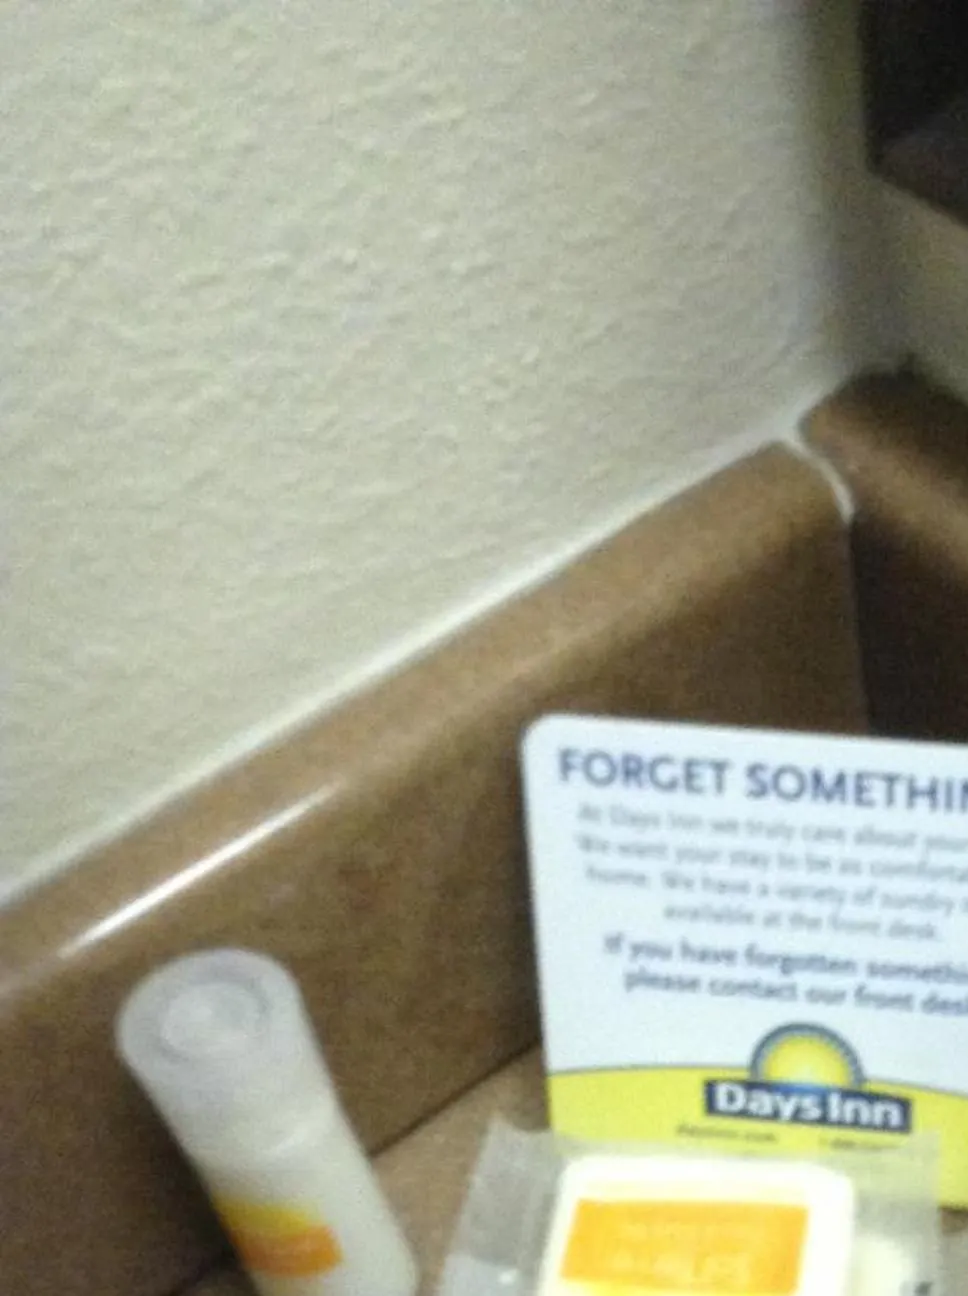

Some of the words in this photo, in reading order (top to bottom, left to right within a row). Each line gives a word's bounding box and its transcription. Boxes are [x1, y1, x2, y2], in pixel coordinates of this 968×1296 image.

[558, 747, 732, 795] FORGET
[629, 940, 673, 965] you
[679, 935, 737, 966] have
[744, 941, 857, 977] forgotten
[623, 965, 701, 993] please
[707, 975, 798, 1003] contact
[805, 987, 846, 1006] our
[853, 982, 915, 1012] front
[714, 1080, 822, 1122] Days
[827, 1090, 904, 1129] Inn
